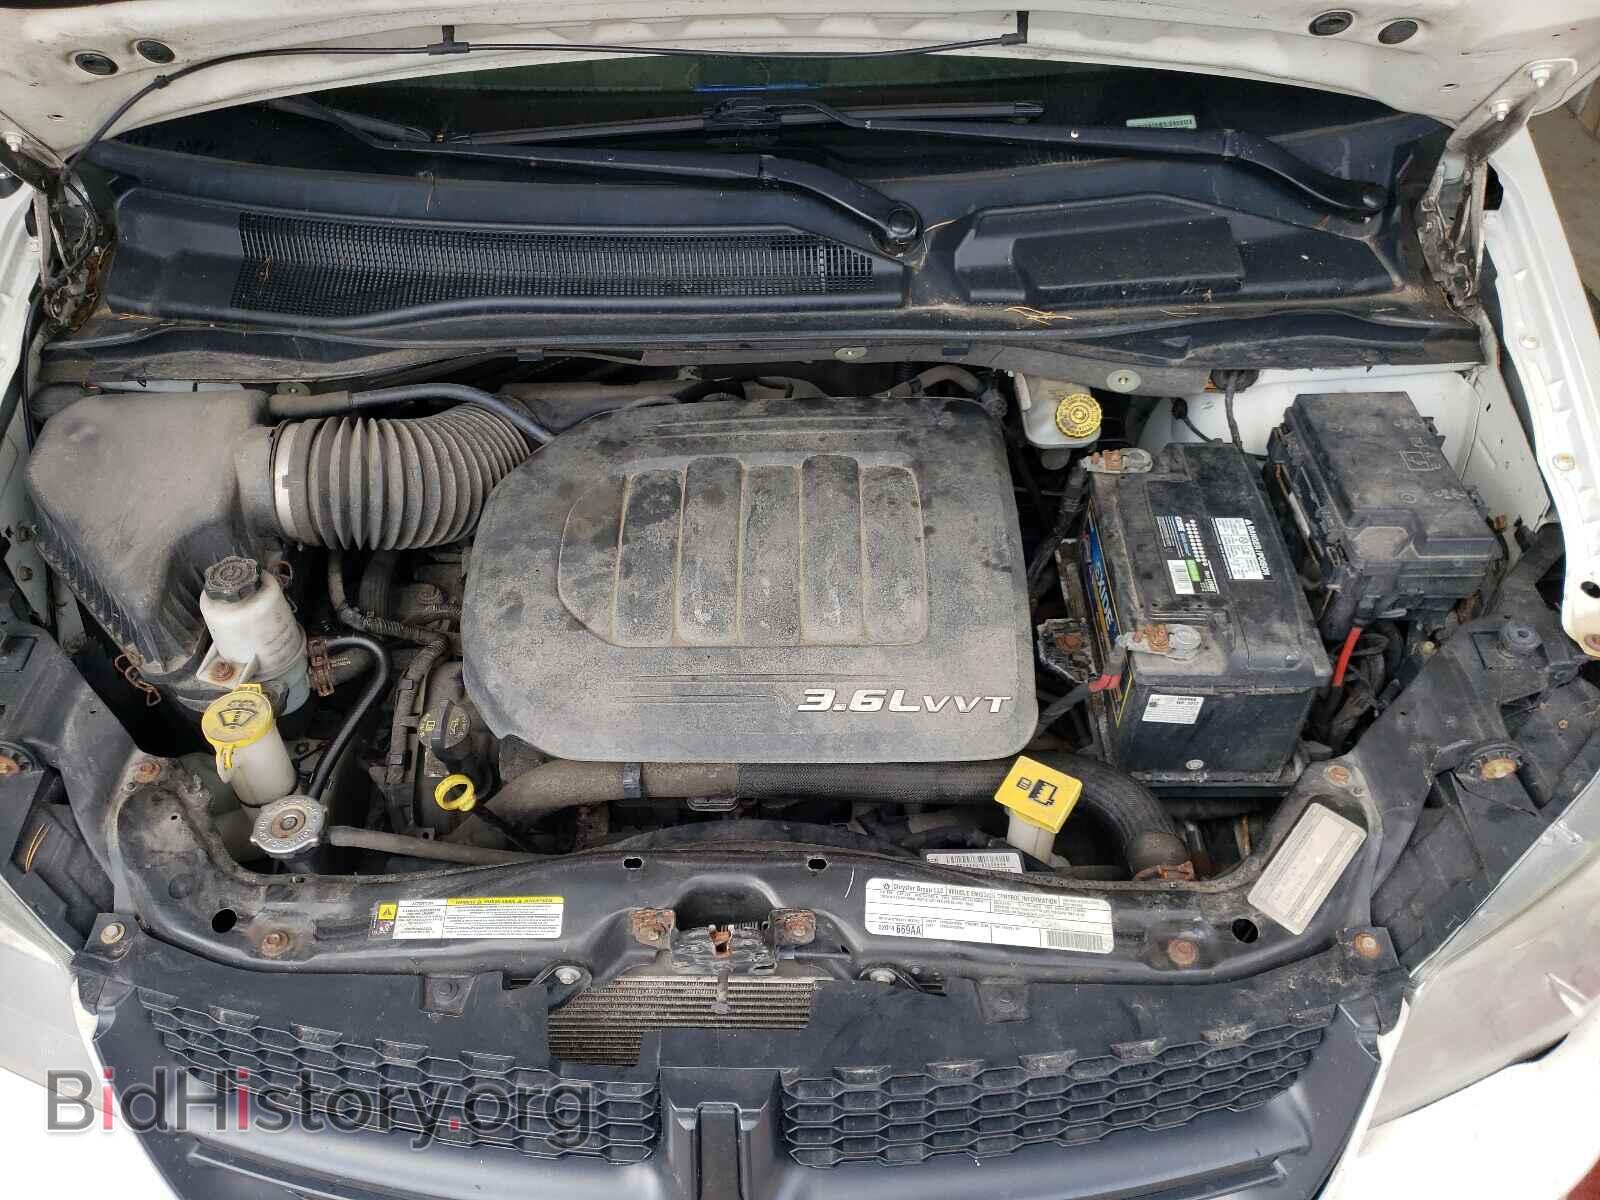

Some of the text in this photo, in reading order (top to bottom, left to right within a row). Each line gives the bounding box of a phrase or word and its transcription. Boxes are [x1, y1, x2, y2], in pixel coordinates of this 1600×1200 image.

[1249, 525, 1262, 550] DANGER
[797, 688, 1012, 713] 3.6L VVT
